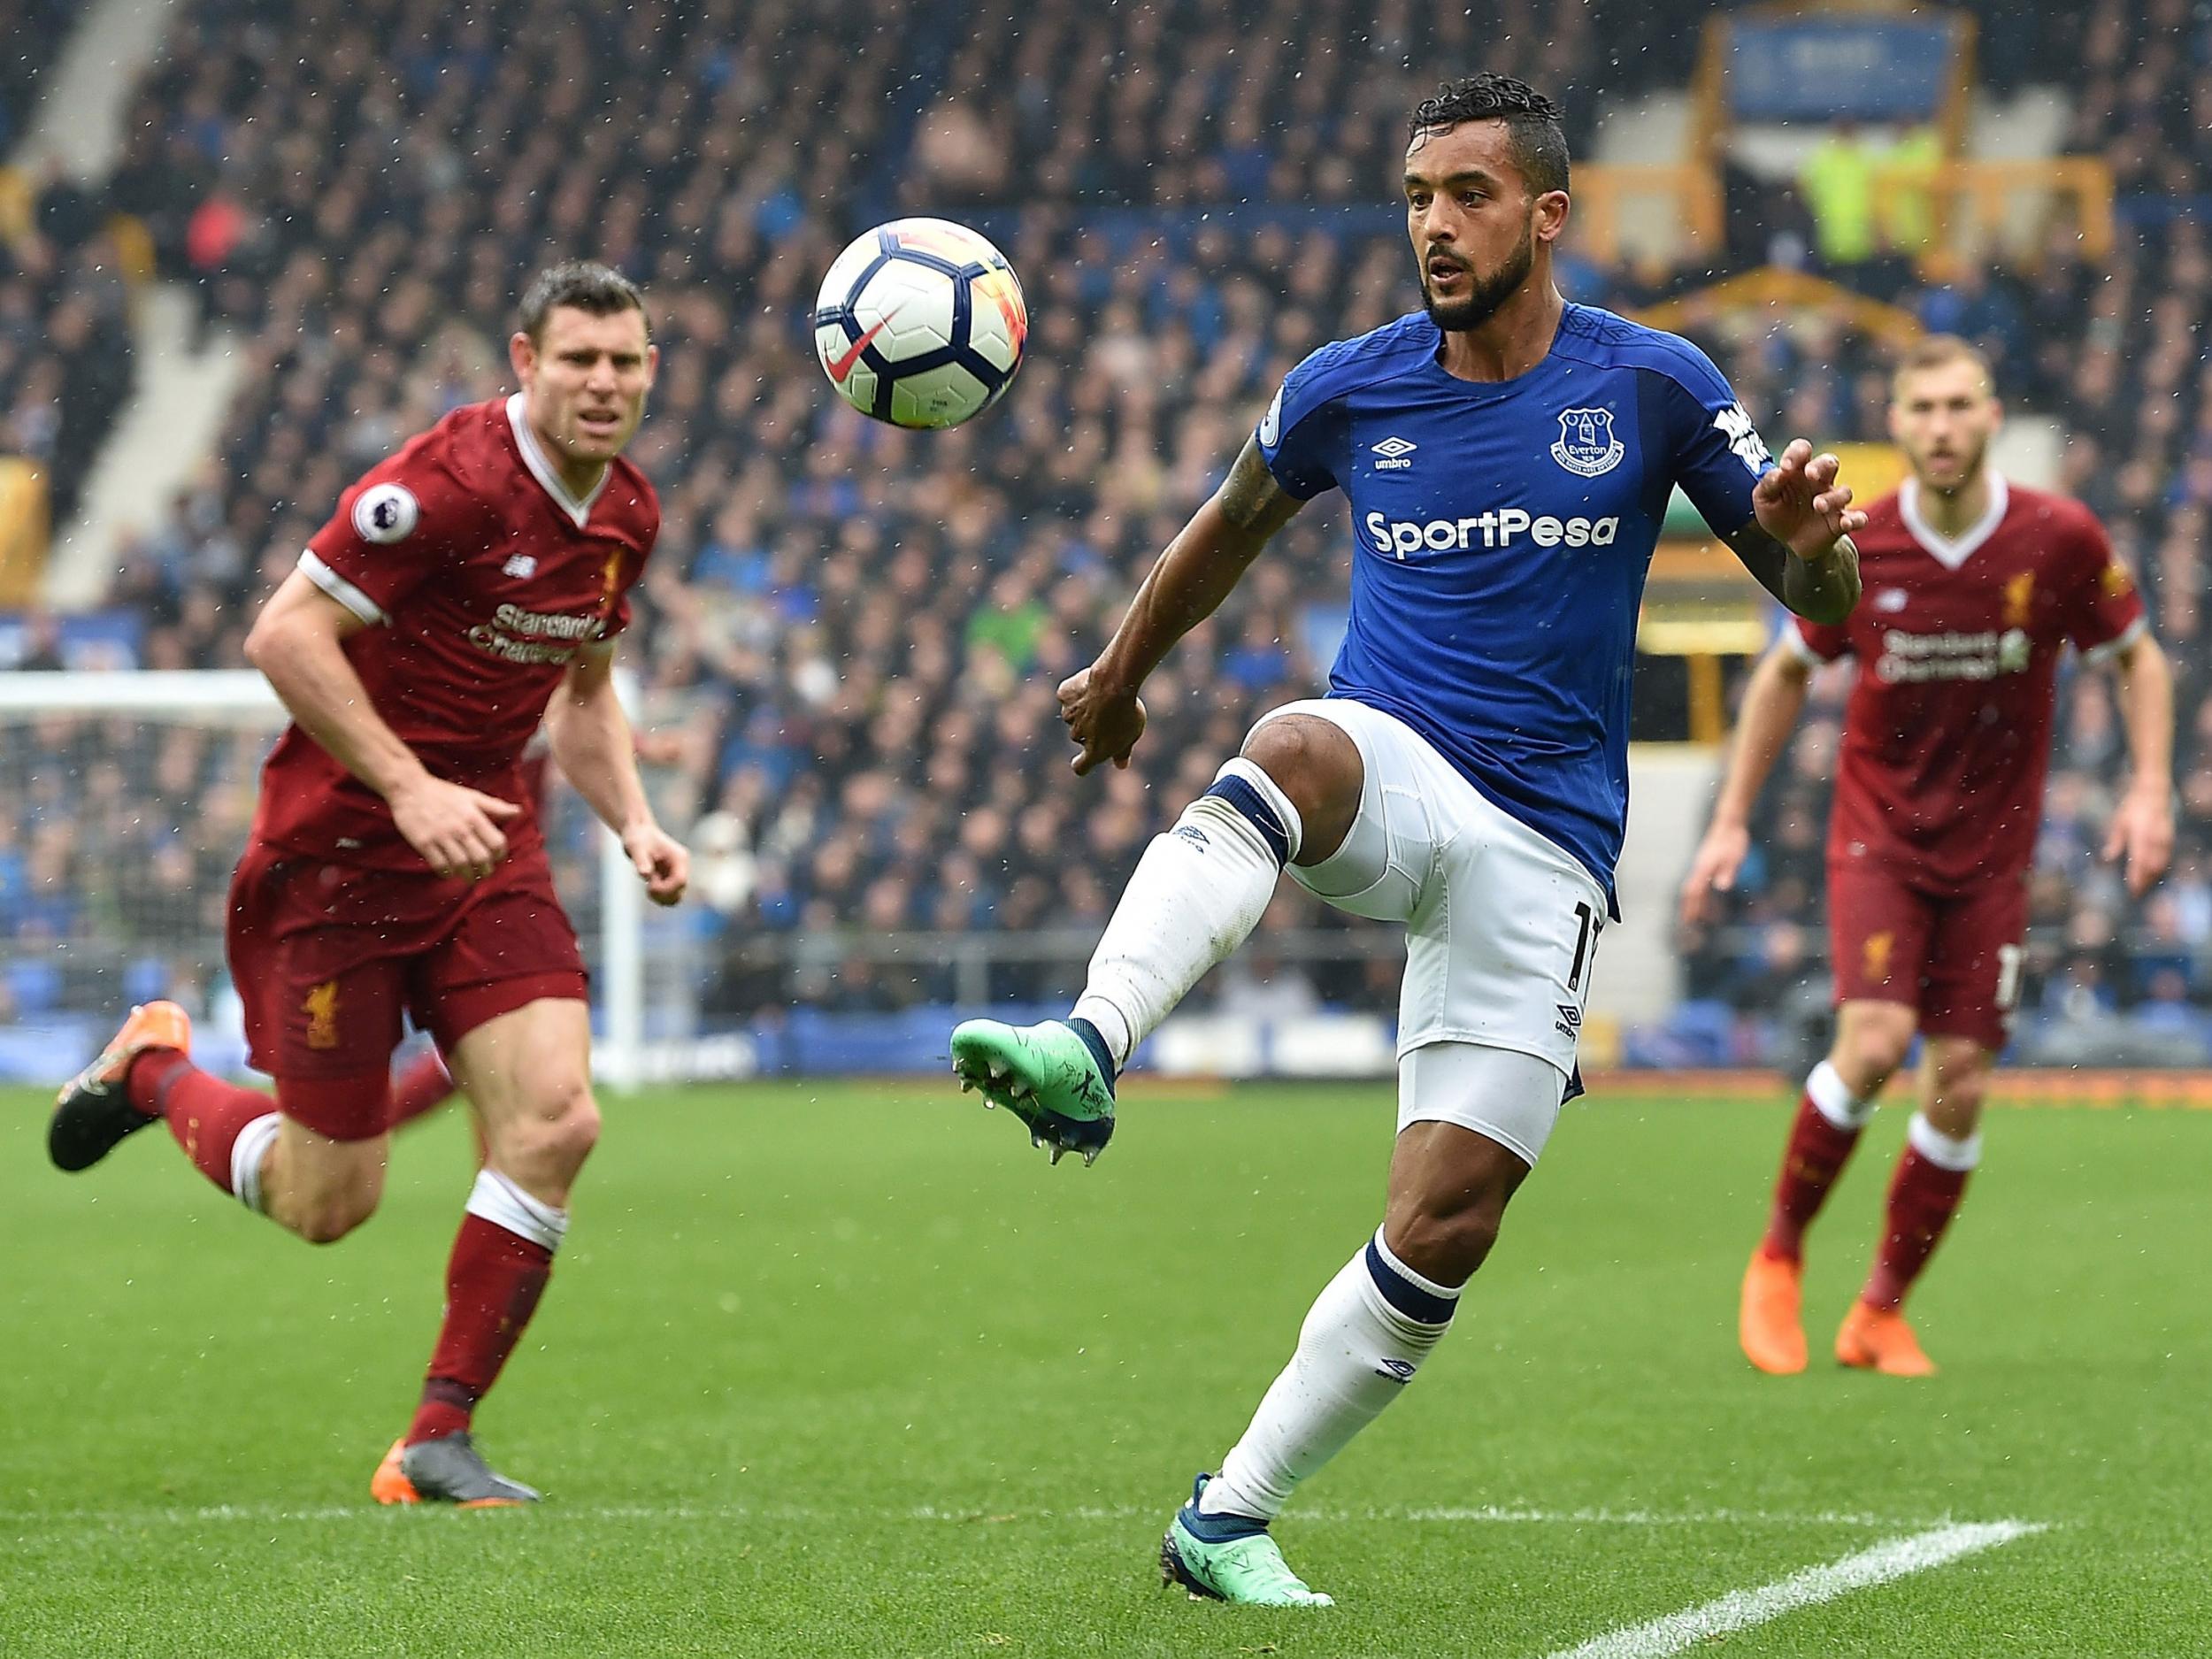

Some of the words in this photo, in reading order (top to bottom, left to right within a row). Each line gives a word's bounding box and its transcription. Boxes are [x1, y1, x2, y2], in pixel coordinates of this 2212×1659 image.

[1568, 445, 1608, 455] Everton
[1375, 457, 1412, 470] umbro
[1366, 508, 1619, 560] SportPesa
[1555, 1020, 1577, 1042] umbr
